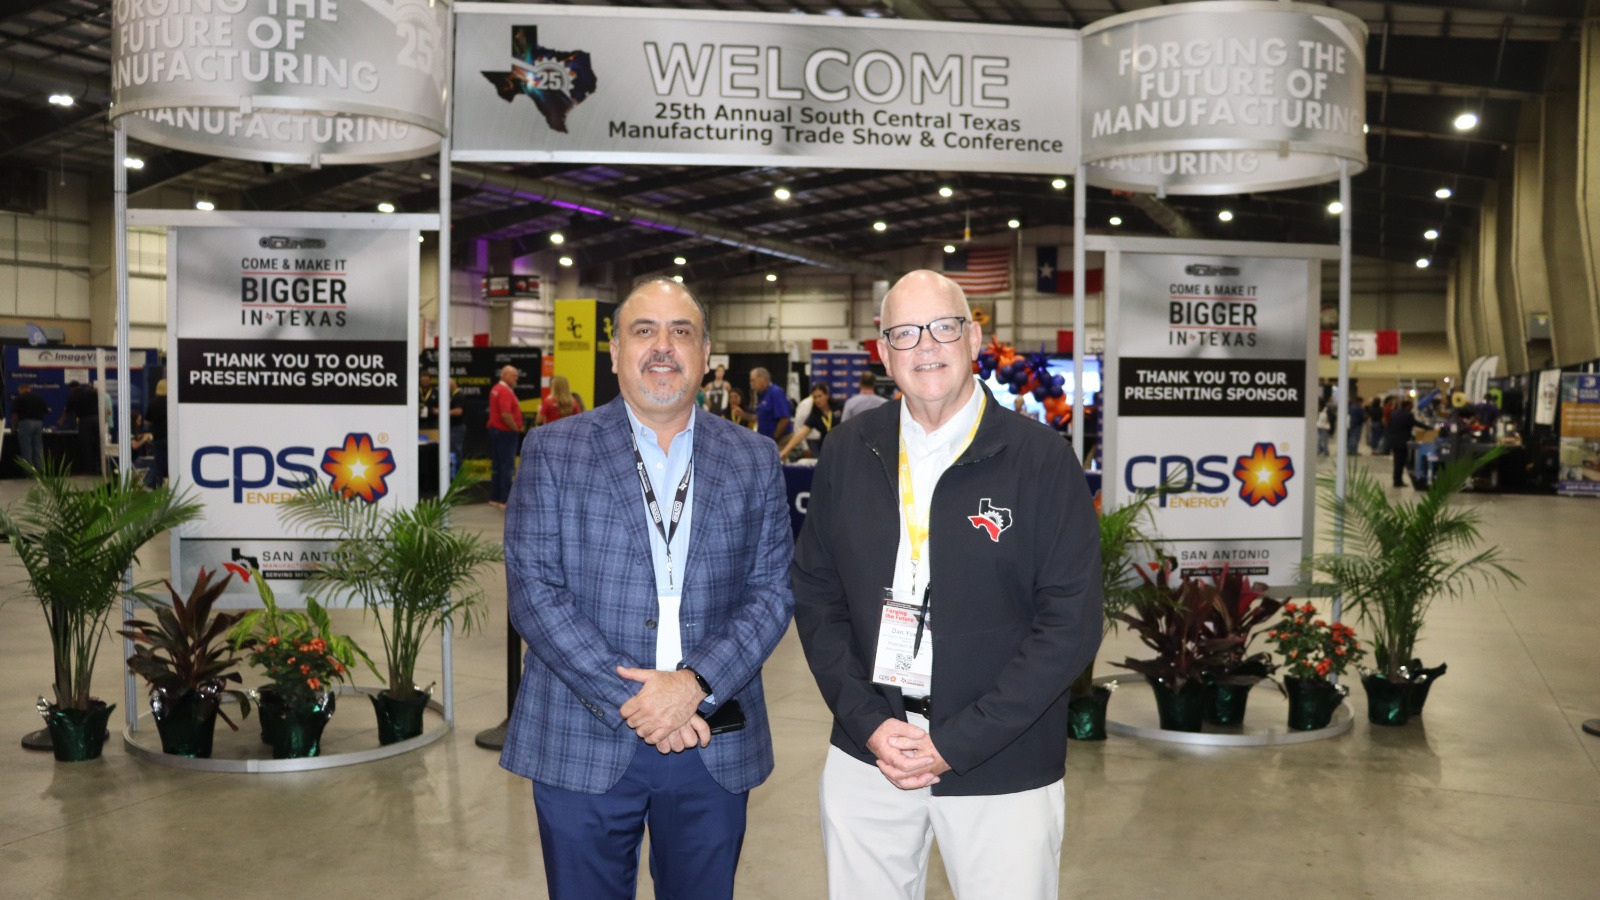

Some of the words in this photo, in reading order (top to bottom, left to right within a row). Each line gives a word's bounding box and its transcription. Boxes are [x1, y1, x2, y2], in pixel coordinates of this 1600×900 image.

[120, 16, 233, 56] FUTURE
[247, 16, 305, 51] OF
[396, 22, 433, 73] 25
[1119, 38, 1288, 76] FORGING
[1298, 41, 1347, 75] THE
[112, 48, 380, 93] ANUFACTURING
[643, 41, 1010, 109] WELCOME
[538, 71, 562, 90] 25
[1140, 68, 1275, 100] FUTURE
[1286, 69, 1328, 100] OF
[655, 102, 705, 120] 25th
[714, 104, 792, 123] Annual
[800, 107, 865, 125] South
[873, 109, 951, 129] Central
[960, 113, 1021, 132] Texas
[608, 121, 773, 146] Manufacturing
[781, 125, 844, 145] Trade
[852, 128, 911, 146] Show
[919, 131, 935, 147] &
[943, 132, 1063, 153] Conference
[241, 257, 279, 271] COME
[281, 258, 291, 270] &
[294, 258, 331, 271] MAKE
[334, 259, 347, 271] IT
[241, 277, 347, 304] BIGGER
[1169, 283, 1200, 295] COME
[1203, 285, 1211, 295] &
[1214, 285, 1244, 297] MAKE
[1247, 285, 1257, 297] IT
[241, 310, 264, 326] IN
[275, 310, 347, 327] TEXAS
[1169, 301, 1257, 326] BIGGER
[1169, 331, 1188, 346] IN
[1198, 332, 1257, 347] TEXAS
[55, 352, 117, 362] ImageVion
[203, 352, 267, 368] THANK
[271, 353, 310, 368] YOU
[314, 354, 340, 369] TO
[345, 354, 384, 369] OUR
[189, 370, 307, 387] PRESENTING
[311, 372, 398, 388] SPONSOR
[1136, 370, 1190, 384] THANK
[1193, 371, 1226, 384] YOU
[1229, 371, 1251, 385] TO
[1254, 372, 1287, 385] OUR
[1124, 387, 1223, 401] PRESENTING
[1226, 388, 1298, 402] SPONSOR
[191, 445, 318, 504] cps
[1124, 455, 1231, 508] cps
[246, 492, 316, 504] ENER
[1170, 496, 1230, 509] ENERGY
[262, 550, 293, 562] SAN
[1180, 550, 1207, 561] SAN
[1212, 549, 1270, 560] ANTONIO
